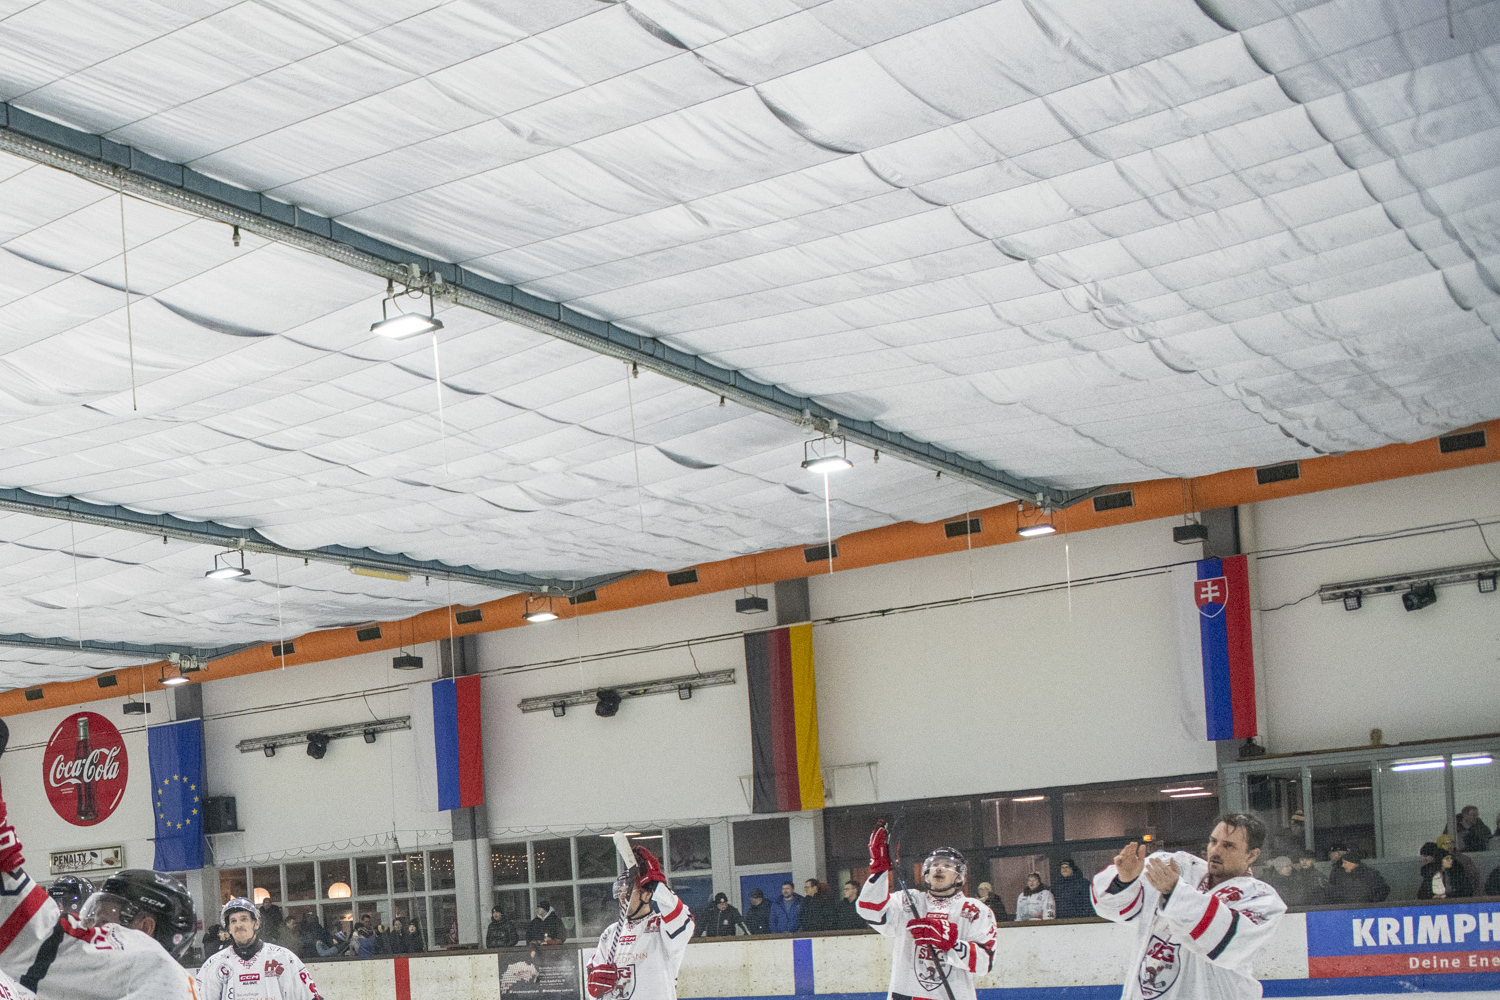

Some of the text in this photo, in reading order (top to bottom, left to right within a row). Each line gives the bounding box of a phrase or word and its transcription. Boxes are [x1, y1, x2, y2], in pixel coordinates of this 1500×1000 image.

[49, 746, 121, 788] Coca-Cola
[53, 852, 87, 866] PENALTY
[1352, 912, 1500, 947] KRIMPH
[1409, 956, 1461, 969] Deine
